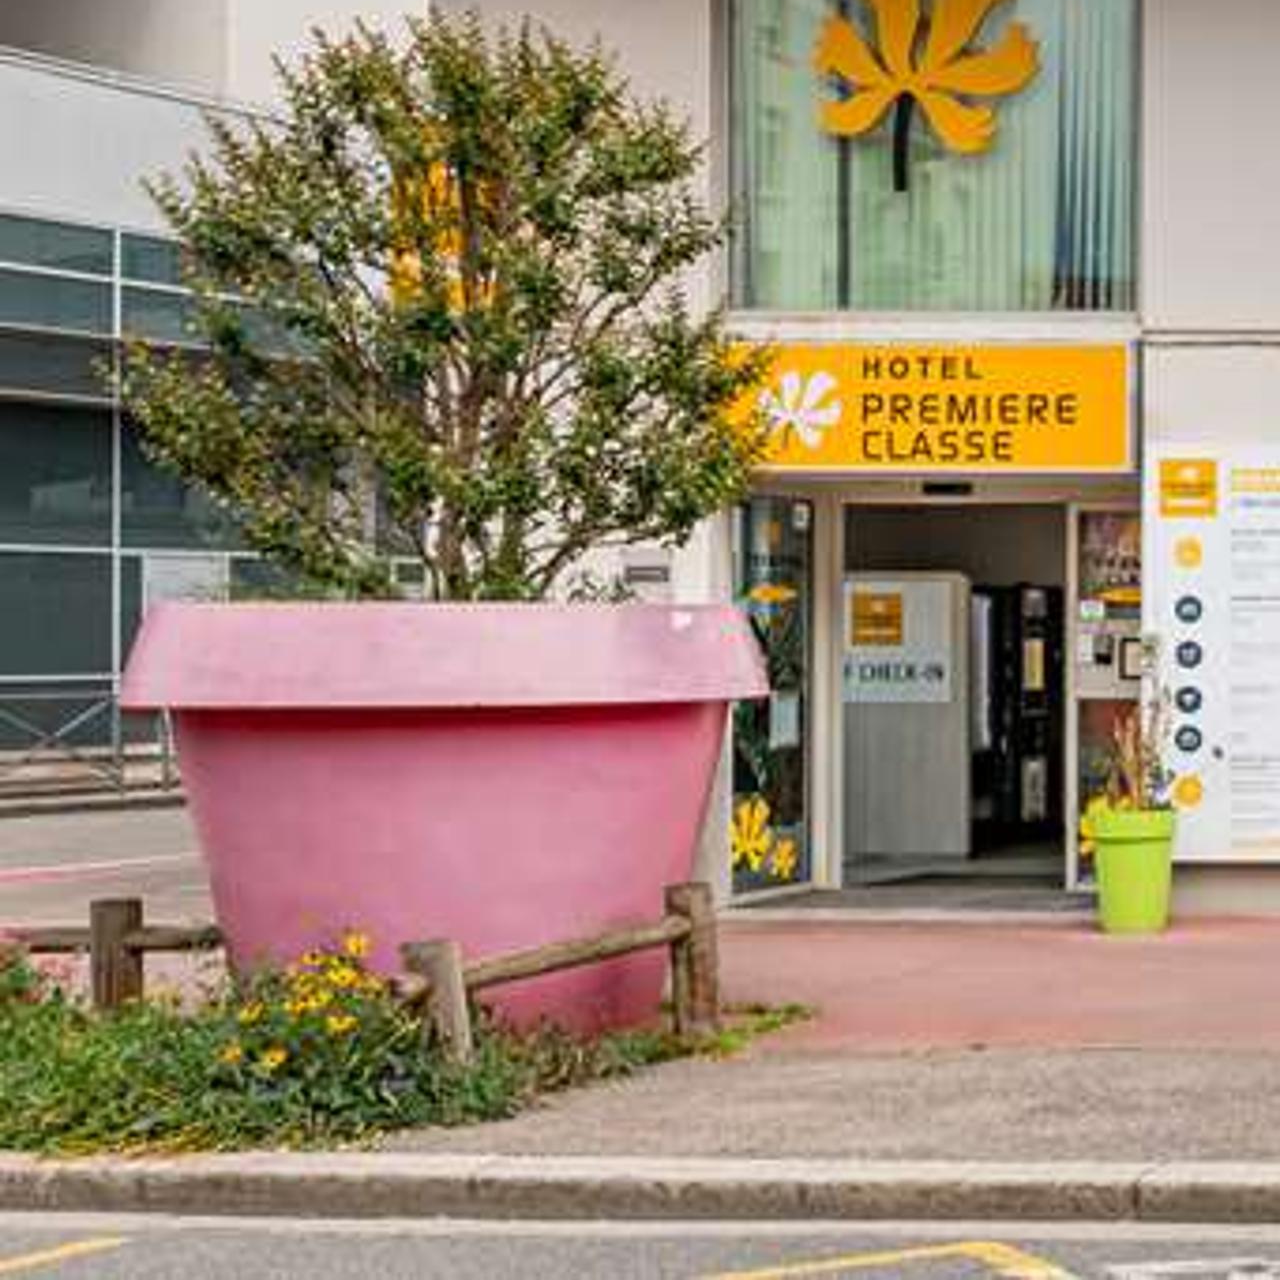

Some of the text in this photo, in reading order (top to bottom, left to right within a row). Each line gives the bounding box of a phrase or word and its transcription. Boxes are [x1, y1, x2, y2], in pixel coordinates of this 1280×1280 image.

[862, 355, 984, 380] HOTEL
[862, 393, 1078, 425] PREMIERE
[862, 430, 1014, 462] CLASSE
